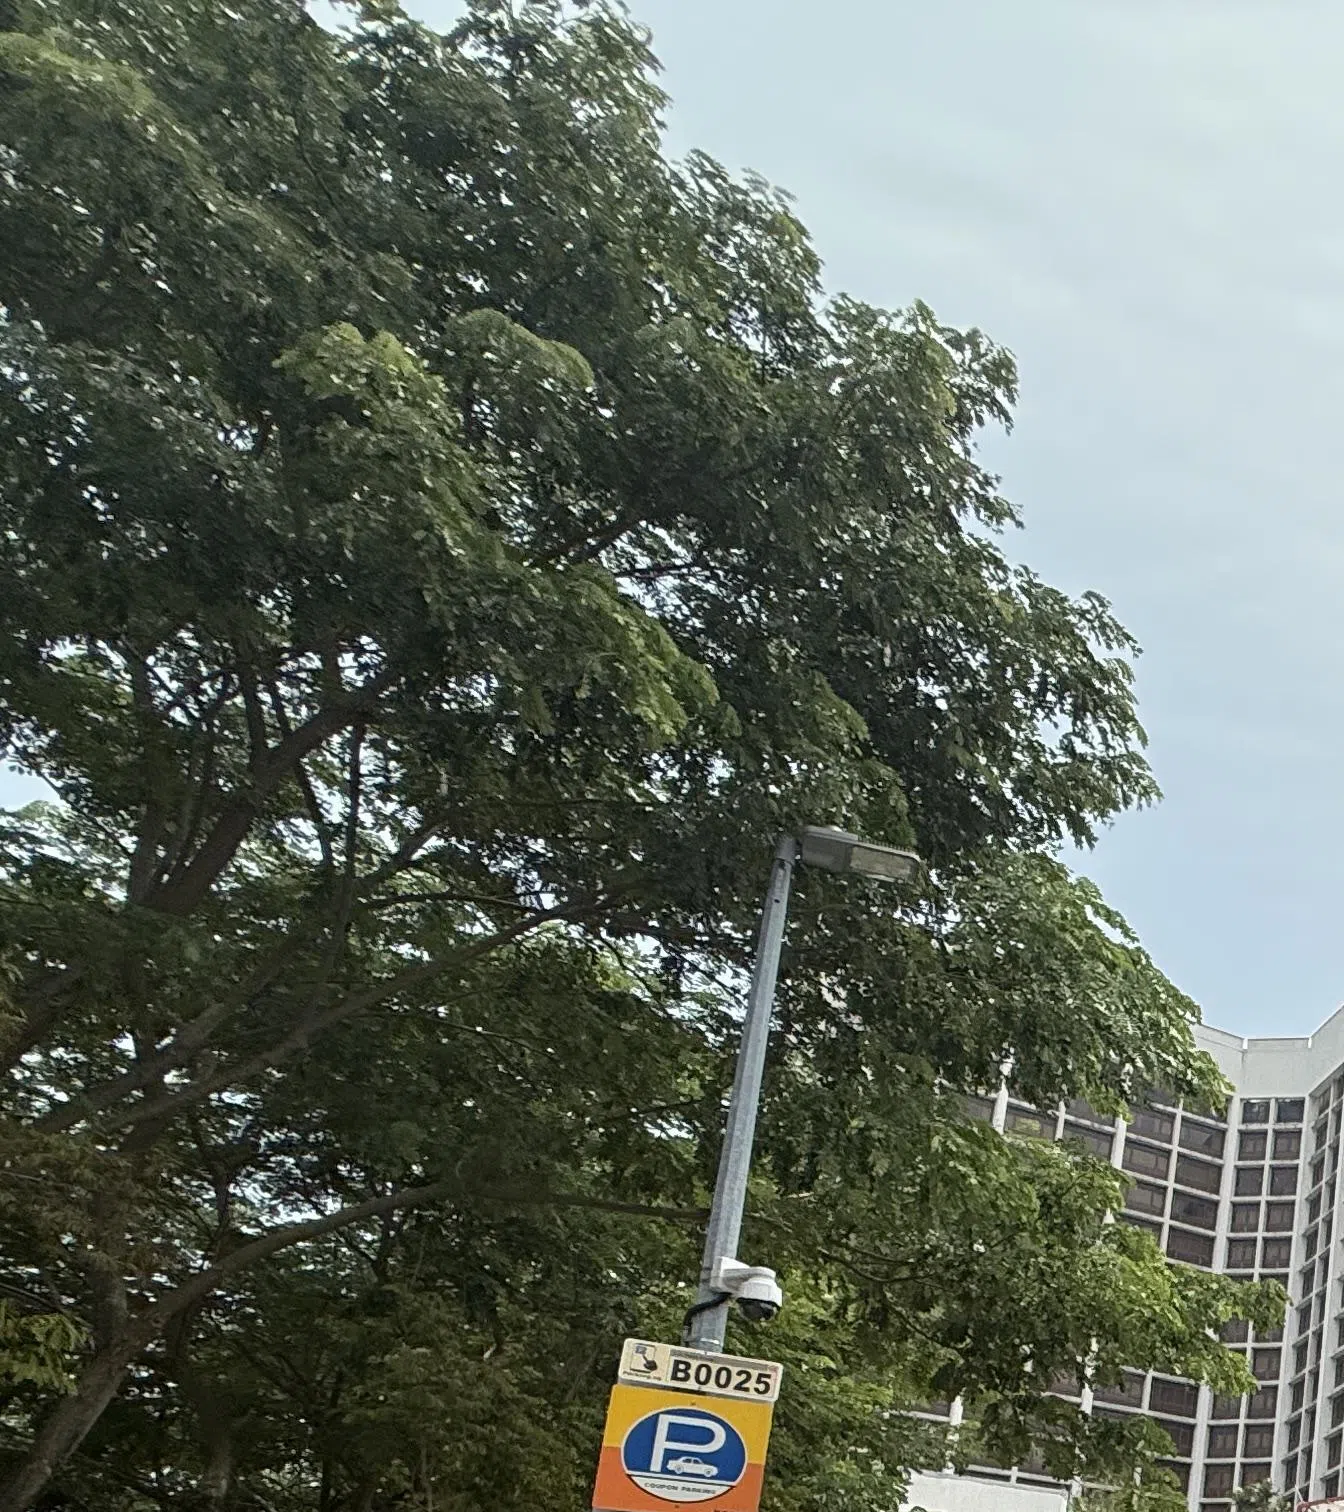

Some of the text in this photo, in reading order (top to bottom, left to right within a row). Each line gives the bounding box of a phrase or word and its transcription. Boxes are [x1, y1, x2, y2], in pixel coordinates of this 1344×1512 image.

[670, 1358, 772, 1395] B0025
[650, 1413, 727, 1472] P
[644, 1482, 716, 1494] COUPON PARKING
